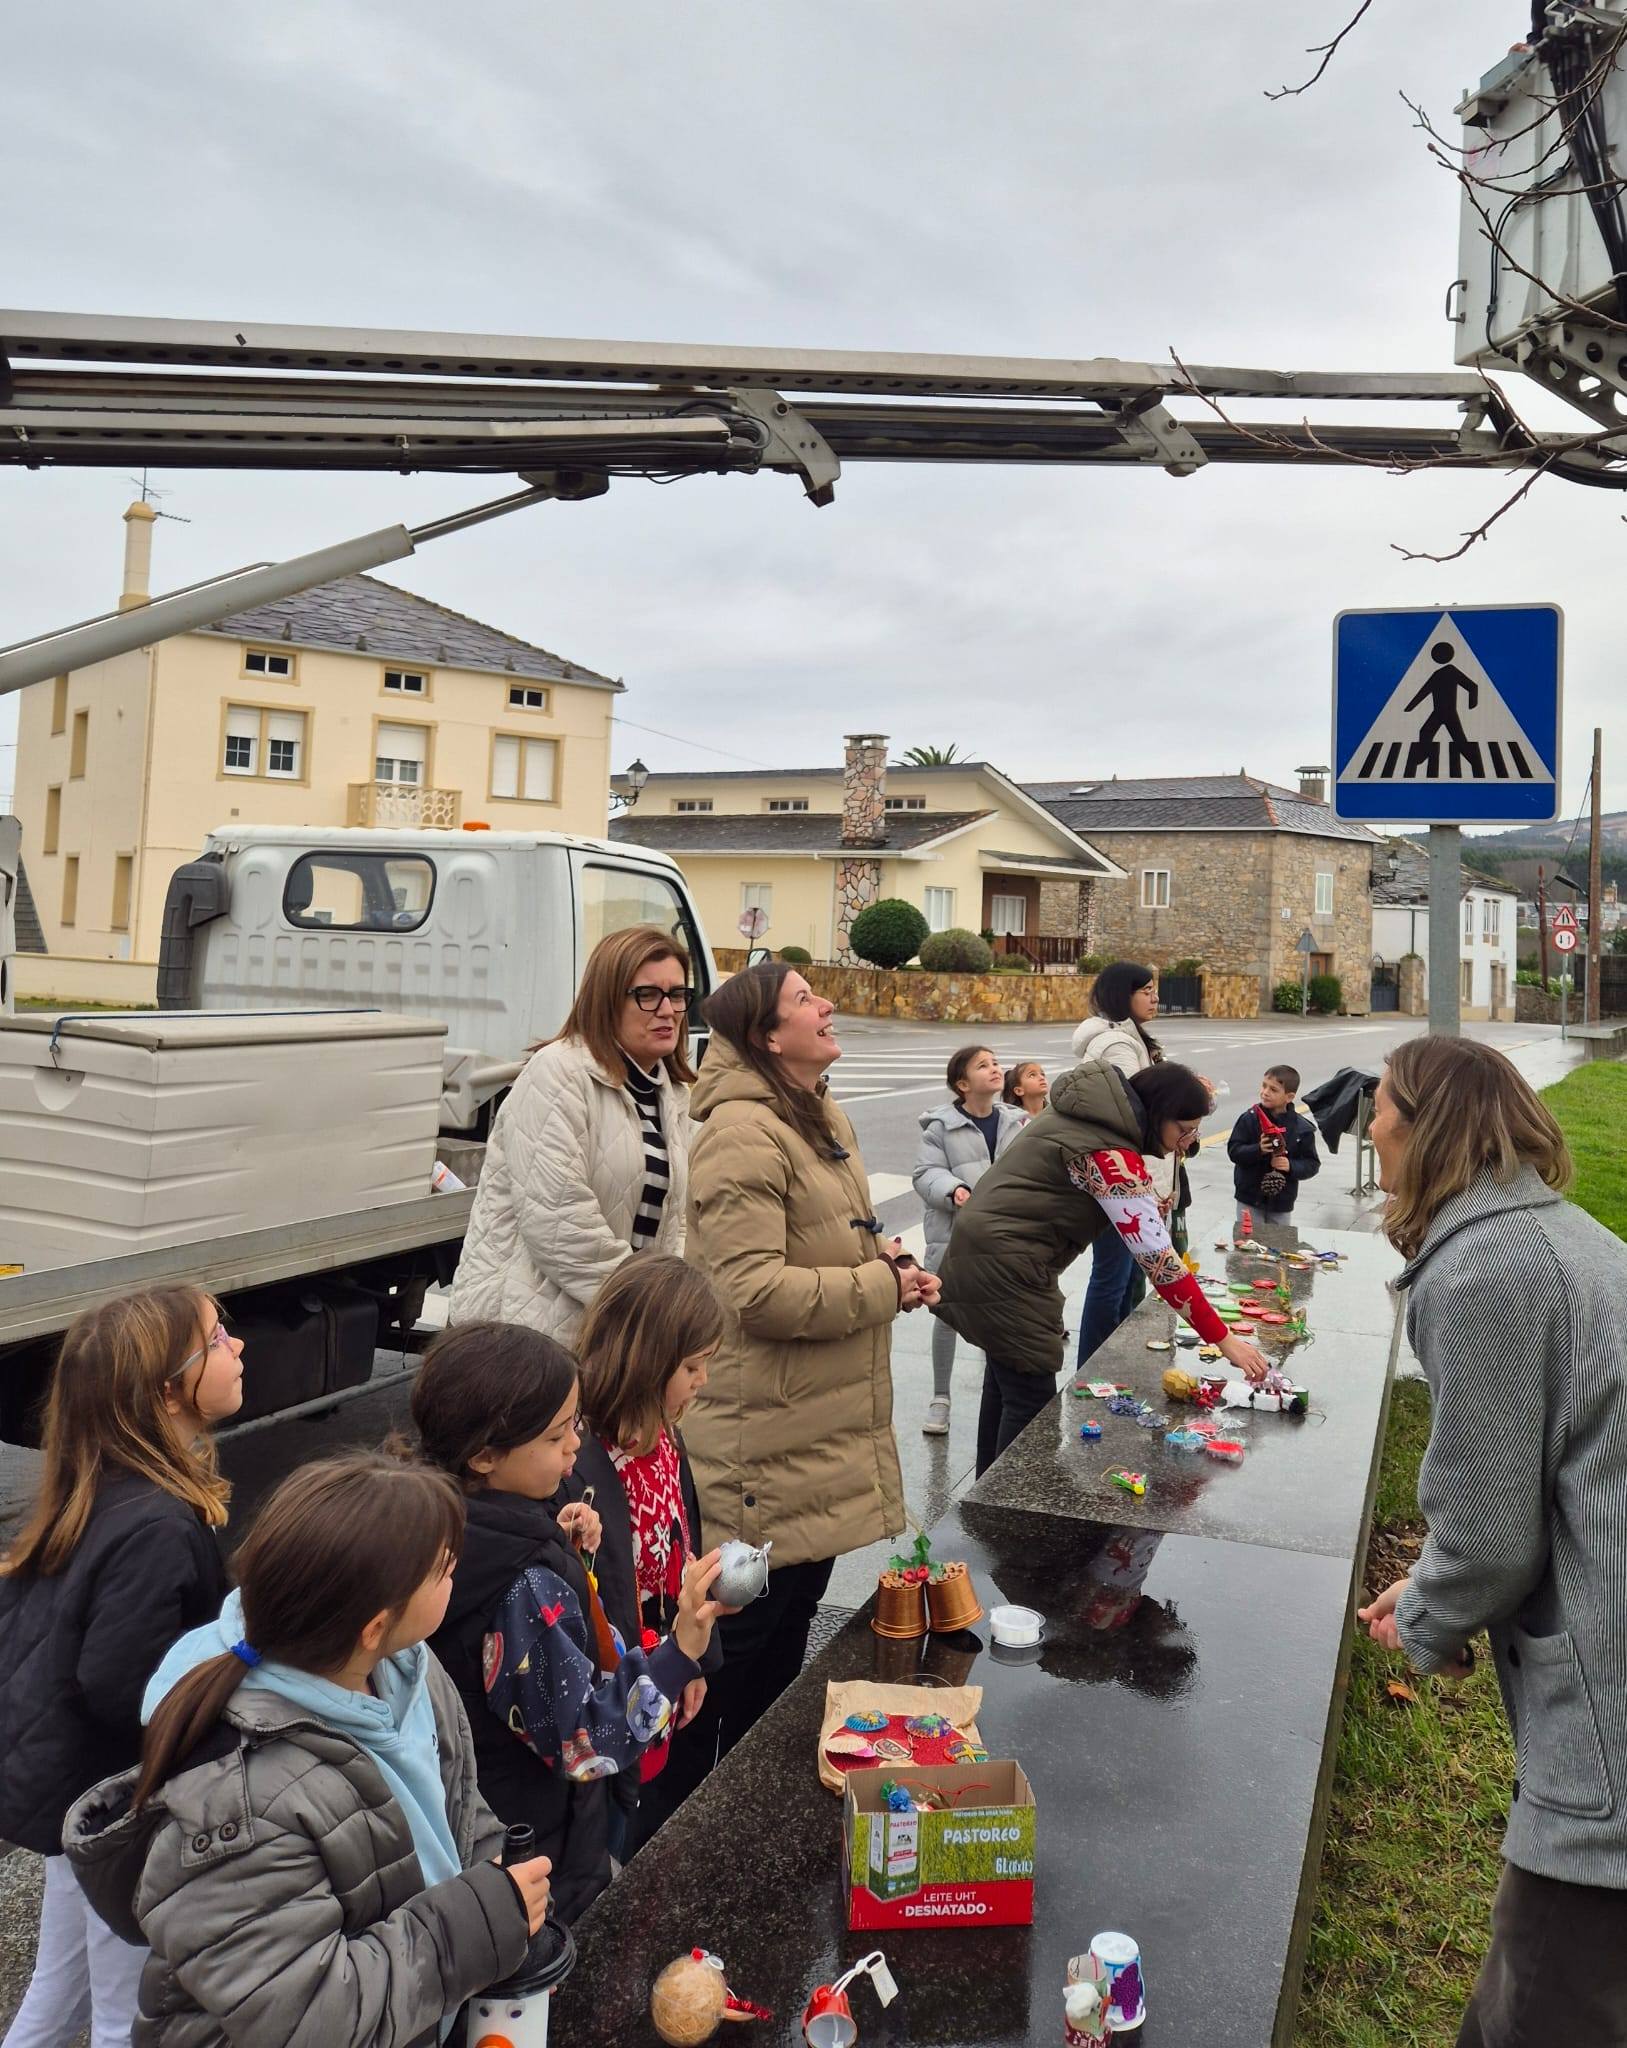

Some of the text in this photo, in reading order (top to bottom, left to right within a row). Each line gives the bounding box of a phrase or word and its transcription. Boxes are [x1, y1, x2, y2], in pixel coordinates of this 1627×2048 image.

[943, 1827, 1021, 1844] PASTOREO
[923, 1891, 977, 1903] LEITE UHT
[905, 1902, 987, 1917] DESNATADO
